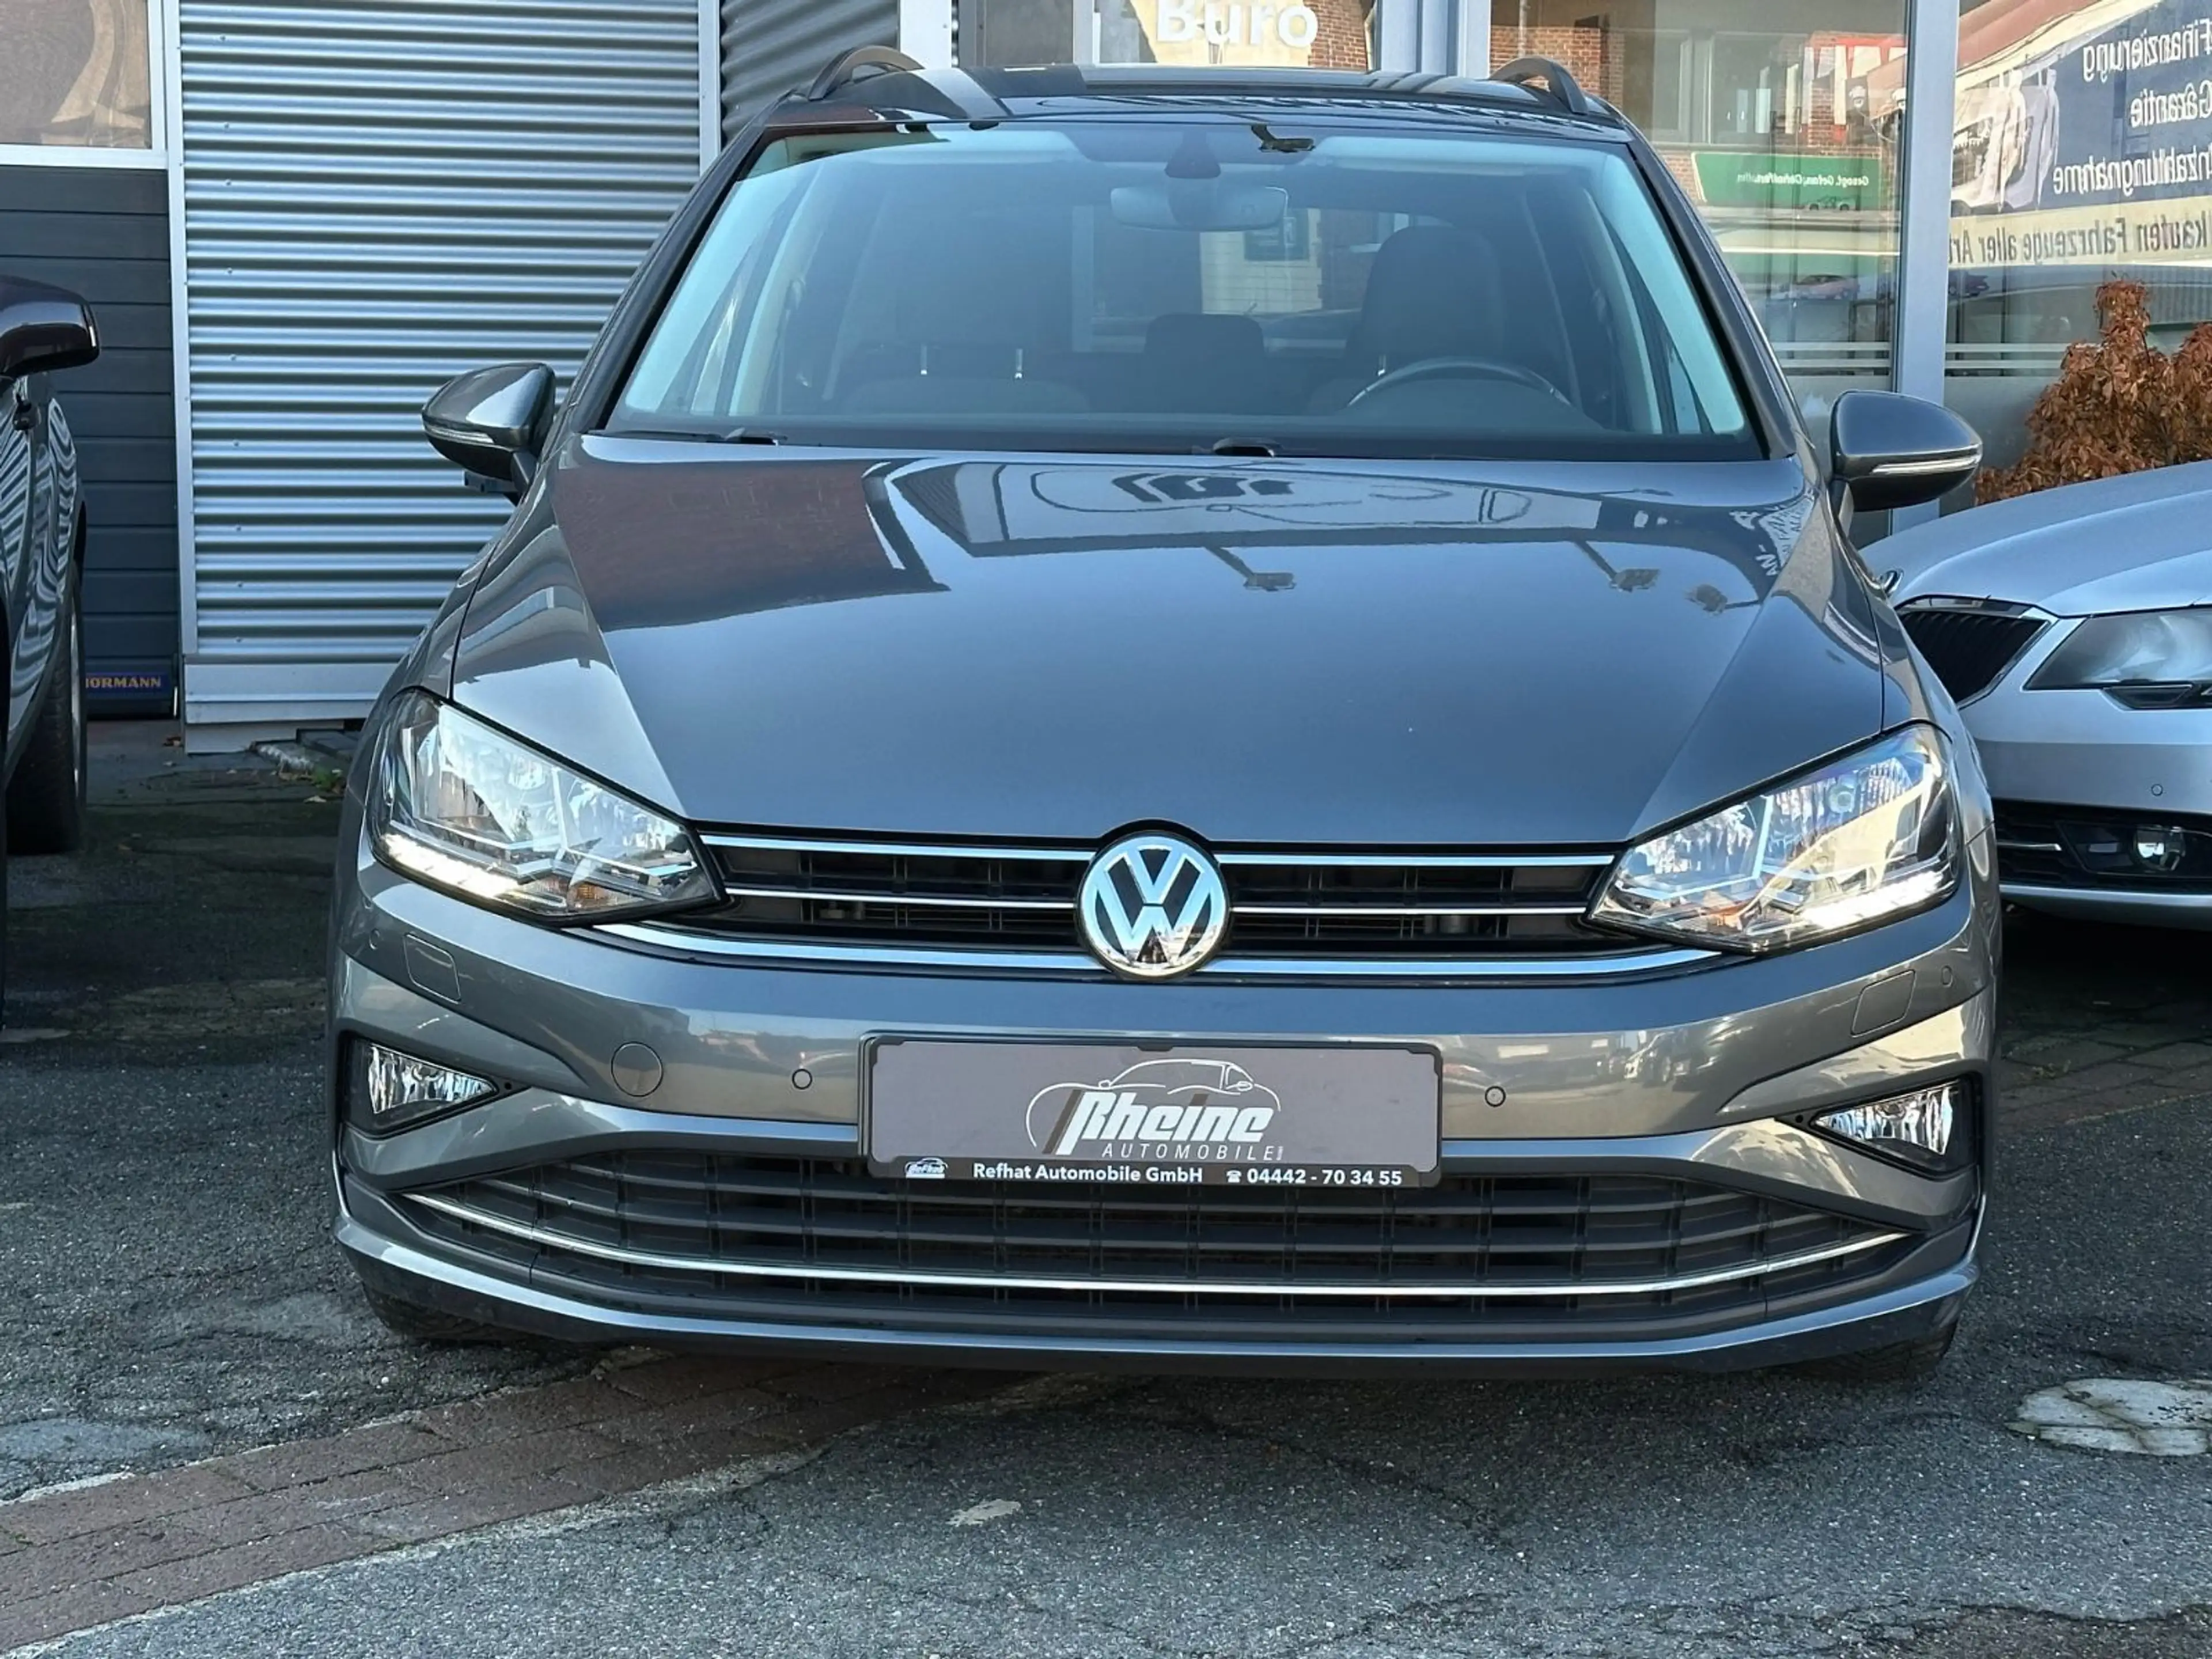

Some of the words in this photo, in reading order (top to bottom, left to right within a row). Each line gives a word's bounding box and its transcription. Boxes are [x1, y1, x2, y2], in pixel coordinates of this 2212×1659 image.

[973, 1163, 1031, 1179] Refhat
[1035, 1163, 1141, 1181] Automobile
[1145, 1166, 1203, 1183] GmbH
[1247, 1168, 1306, 1184] 04442
[1322, 1169, 1345, 1185] 70
[1350, 1170, 1374, 1185] 34
[1378, 1171, 1402, 1185] 55
